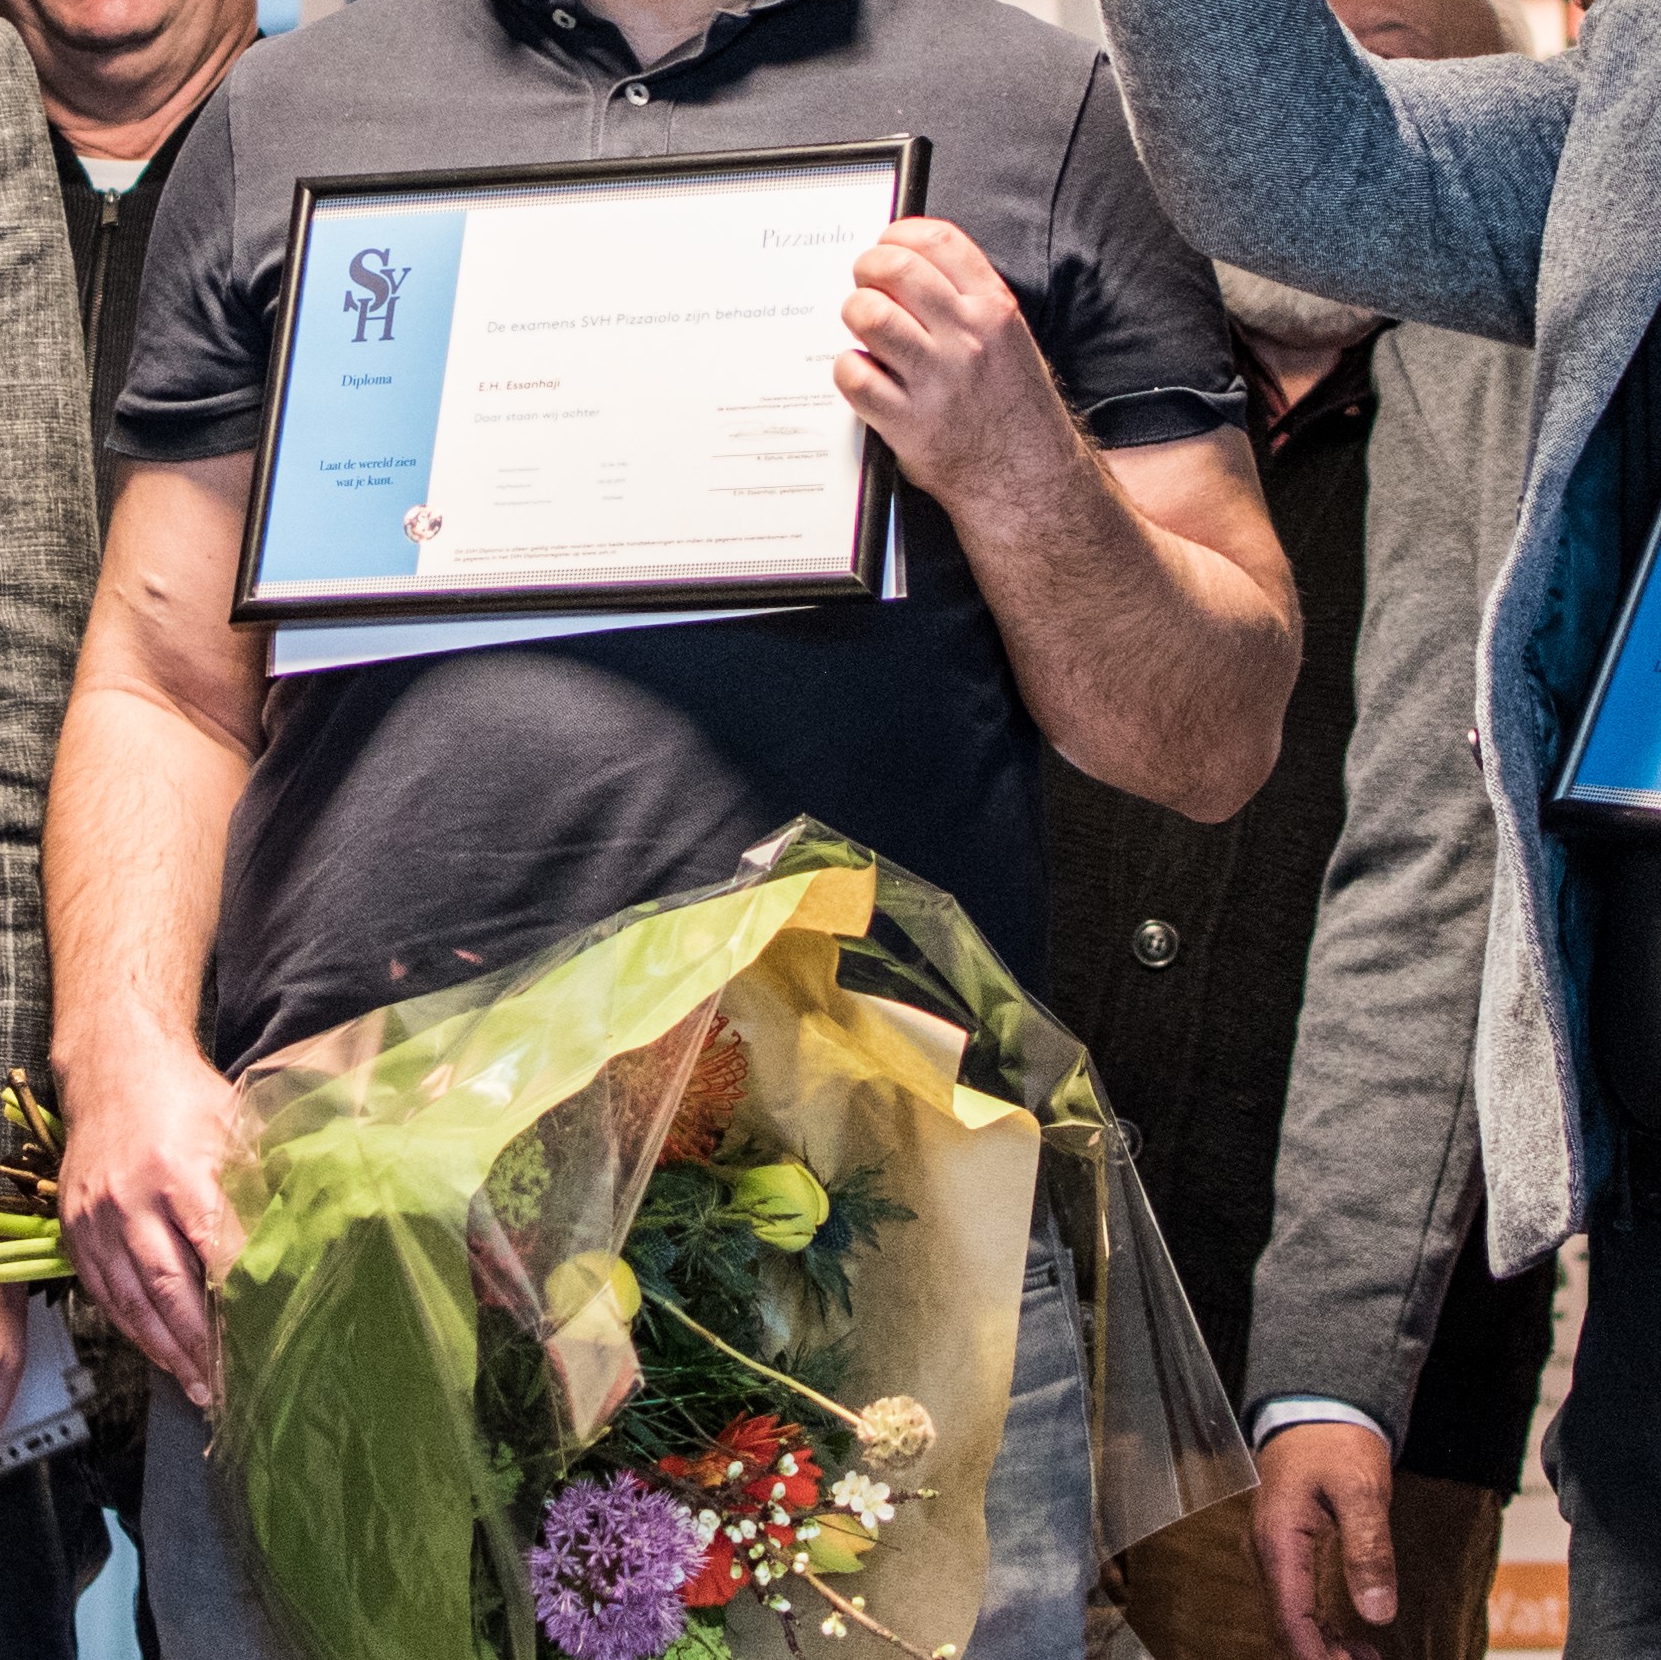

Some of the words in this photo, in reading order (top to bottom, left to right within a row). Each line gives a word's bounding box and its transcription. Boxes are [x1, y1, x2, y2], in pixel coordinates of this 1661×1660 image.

[762, 224, 855, 249] Pizzaiolo
[487, 321, 506, 334] De
[511, 319, 576, 333] examens
[581, 315, 612, 329] SVH
[616, 311, 680, 326] Pizzaiolo
[685, 308, 710, 324] zijn
[715, 305, 776, 320] behaald
[781, 304, 815, 317] door
[342, 373, 392, 389] Diploma
[478, 382, 502, 392] E.H.
[506, 378, 561, 390] Essanhaji
[474, 413, 502, 423] Daar
[506, 411, 538, 422] staan
[542, 409, 559, 421] wij
[562, 407, 600, 418] achter
[320, 460, 341, 471] Laat
[343, 459, 356, 470] de
[359, 457, 394, 469] wereld
[394, 456, 417, 467] zien
[336, 478, 353, 487] wat
[354, 476, 365, 490] je
[367, 476, 394, 486] kunt.
